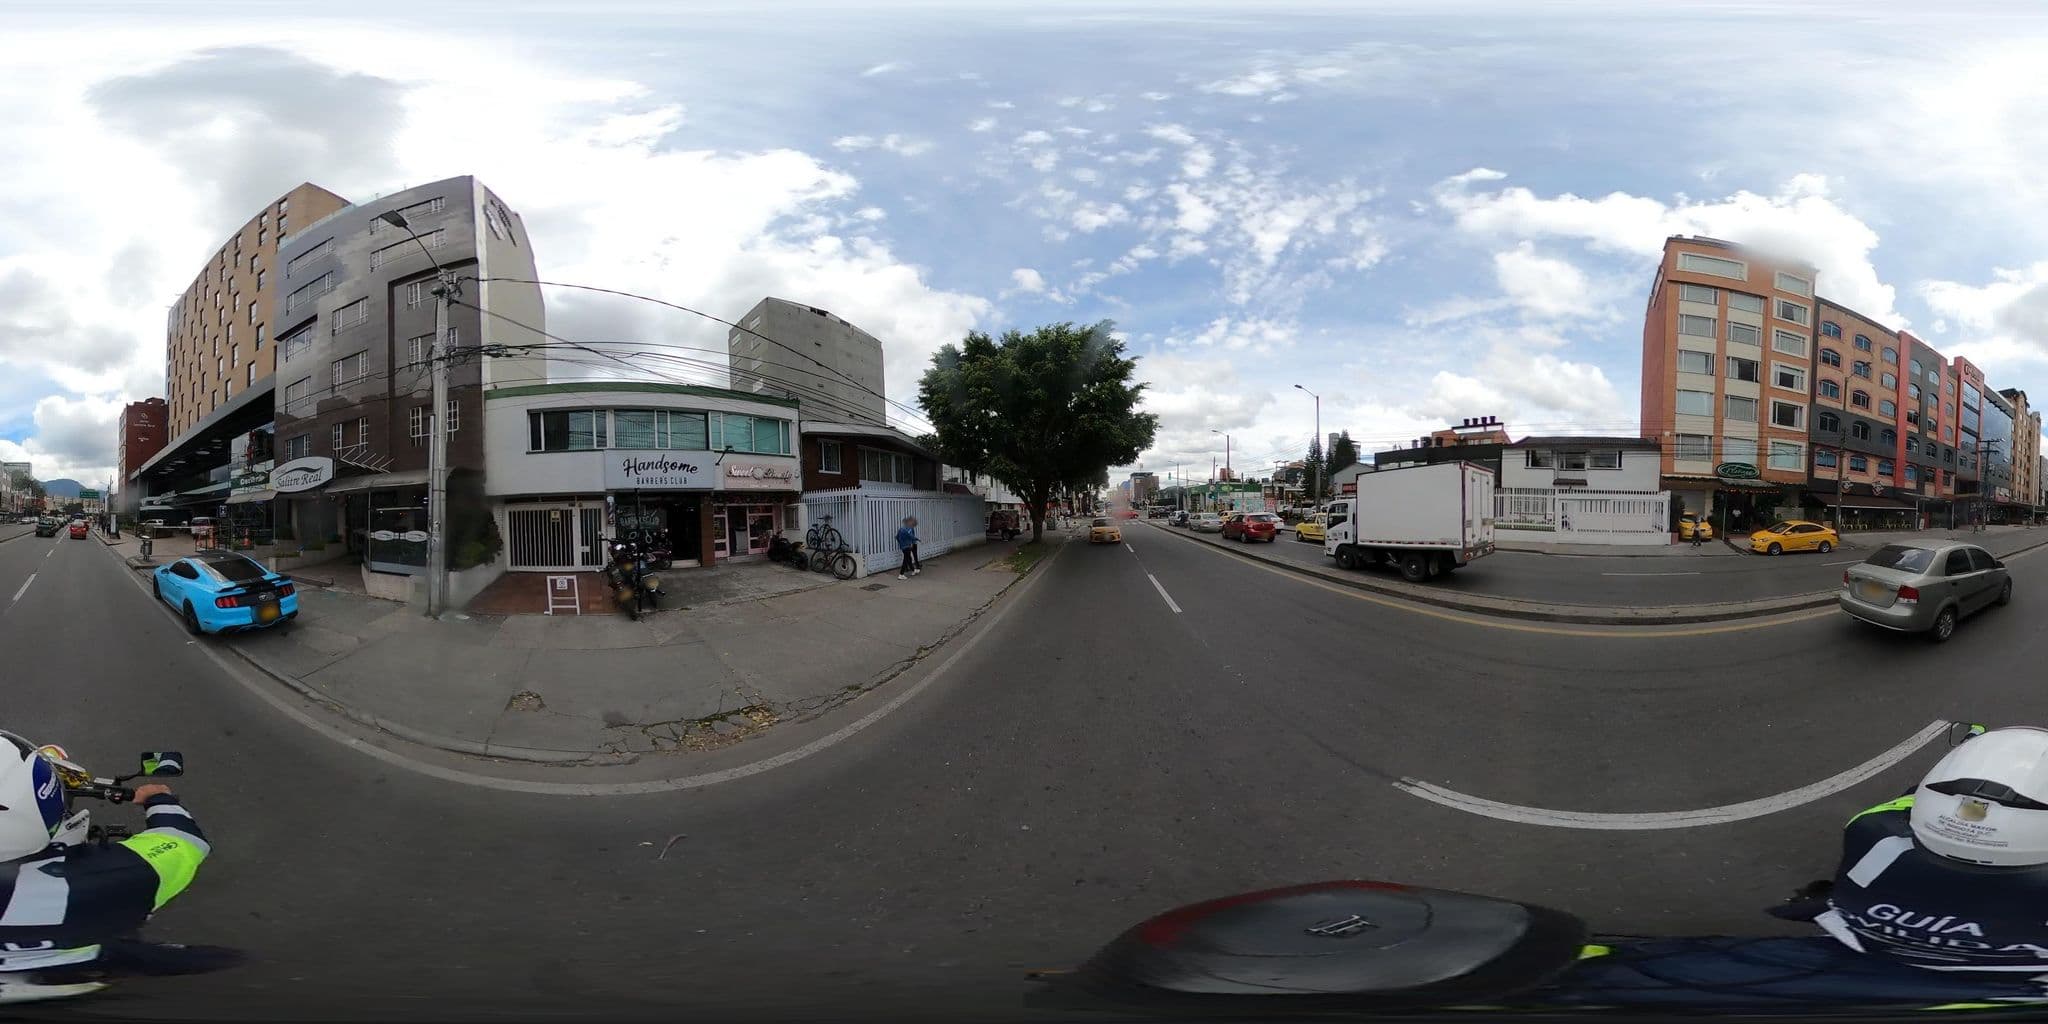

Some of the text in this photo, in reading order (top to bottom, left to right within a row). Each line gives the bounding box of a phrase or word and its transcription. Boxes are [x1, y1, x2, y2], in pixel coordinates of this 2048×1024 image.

[623, 454, 698, 477] Handsome
[277, 475, 300, 488] Salitre
[301, 468, 322, 485] Real
[670, 477, 688, 485] CLUB
[1866, 903, 1984, 937] GUÍA
